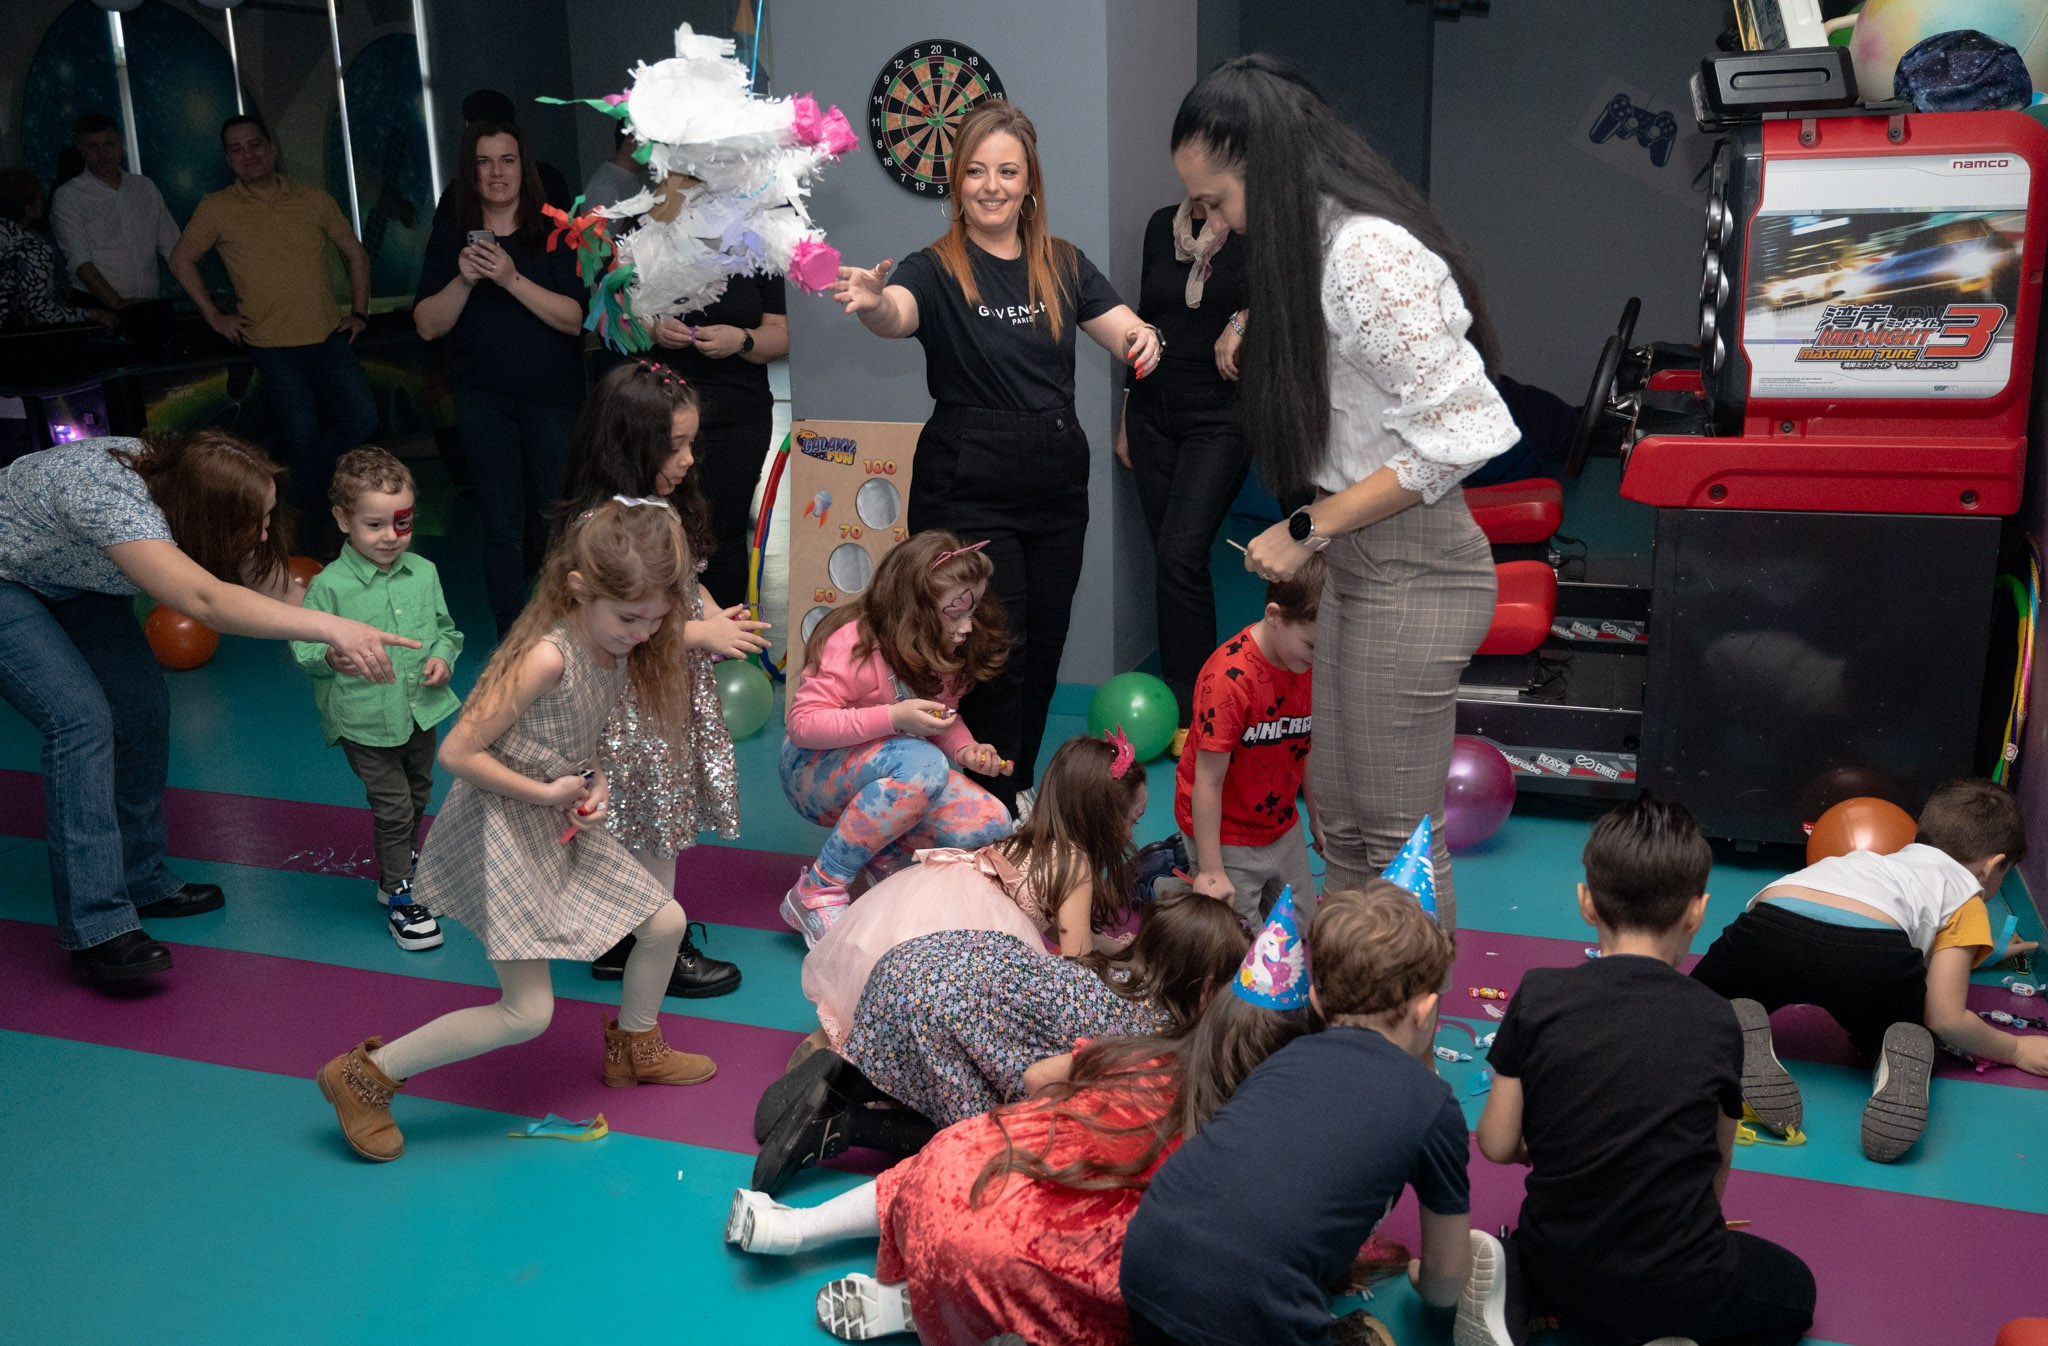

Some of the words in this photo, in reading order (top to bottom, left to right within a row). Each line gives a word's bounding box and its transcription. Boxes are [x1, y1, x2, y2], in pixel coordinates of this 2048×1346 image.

[914, 49, 920, 59] 5
[930, 45, 942, 54] 20
[952, 48, 957, 57] 1
[894, 59, 904, 69] 12
[968, 56, 978, 66] 18
[883, 75, 890, 84] 9
[984, 73, 990, 82] 4
[873, 96, 883, 105] 14
[871, 118, 880, 127] 11
[877, 140, 883, 149] 8
[883, 157, 893, 167] 16
[1953, 159, 2009, 169] namco
[900, 173, 907, 182] 7
[915, 182, 926, 191] 19
[937, 185, 944, 194] 3
[978, 301, 1047, 319] GIVENCH
[1012, 315, 1034, 326] PARIS
[1817, 303, 1892, 331] 湾岸
[1885, 317, 1940, 329] ミッドナイト
[1815, 324, 1938, 347] MIDNIGHT
[1921, 304, 2008, 362] 3
[802, 436, 857, 454] GALAXY
[826, 450, 855, 466] FUN
[863, 459, 898, 475] 100
[838, 524, 863, 540] 70
[813, 587, 837, 604] 50
[1497, 748, 1542, 775] atanabe
[1537, 752, 1572, 774] RAYS
[1594, 762, 1619, 780] ENKEI
